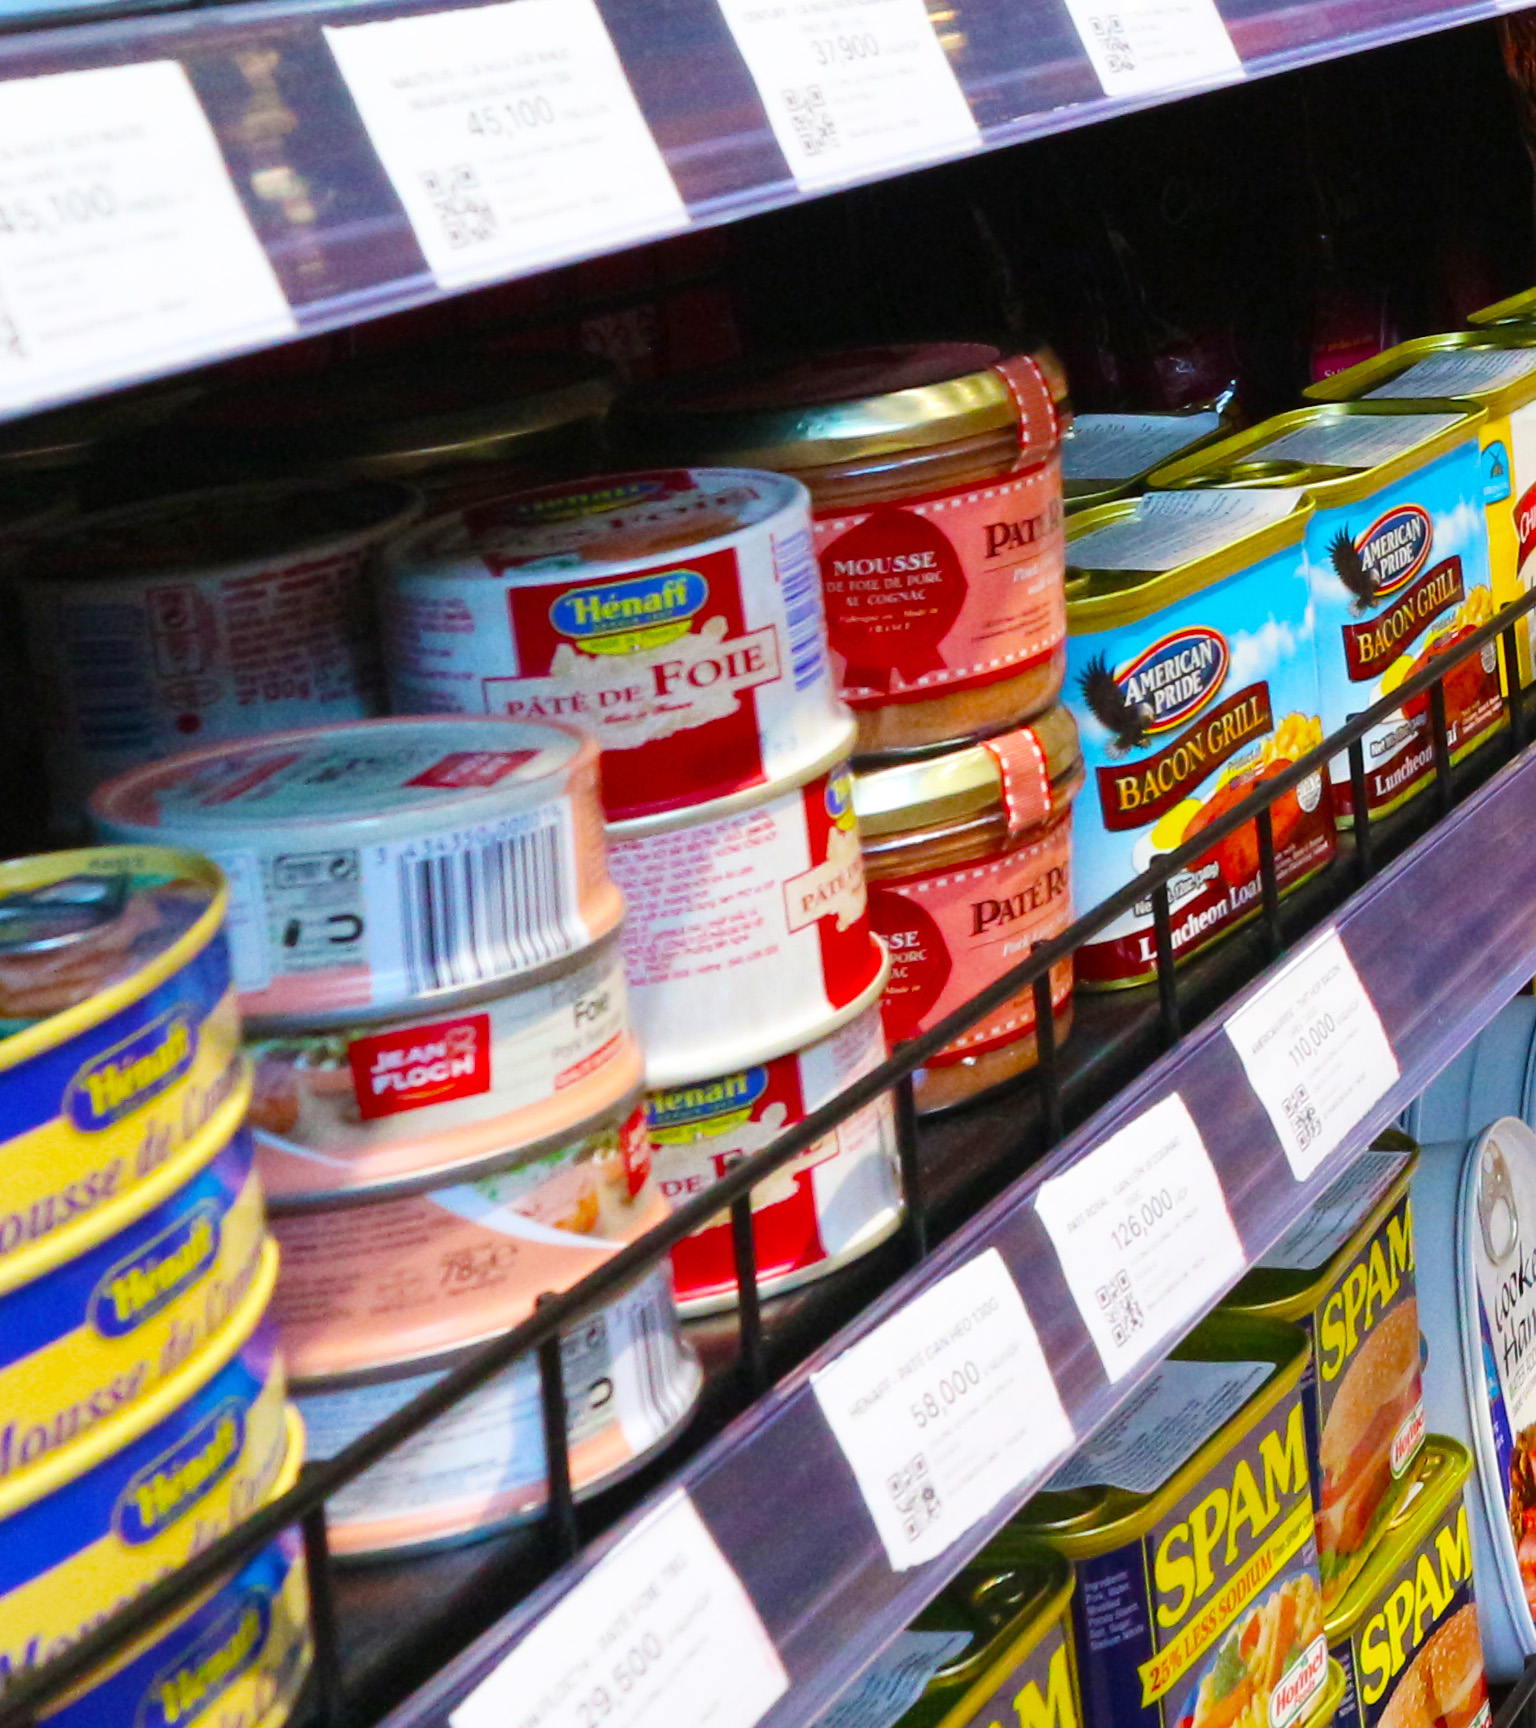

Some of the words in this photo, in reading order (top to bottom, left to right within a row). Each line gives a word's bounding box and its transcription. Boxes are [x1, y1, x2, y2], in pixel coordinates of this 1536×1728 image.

[812, 31, 881, 69] 37,900
[833, 550, 938, 577] MOUSSE
[1362, 514, 1421, 569] AMERICAN
[1380, 542, 1414, 577] PRIDE
[566, 573, 690, 627] Hénaff
[1357, 596, 1415, 663] BACON
[1416, 568, 1460, 617] GRILL
[506, 686, 590, 719] PÂTÉ
[599, 688, 644, 711] DE
[651, 641, 766, 698] FOIE
[1124, 638, 1213, 707] AMERICAN
[1154, 671, 1204, 716] PRIDE
[1114, 739, 1206, 812] BACON
[1208, 696, 1265, 760] GRILL
[1374, 744, 1433, 796] Luncheon
[370, 1040, 447, 1073] JEAN
[1110, 1187, 1173, 1252] 126,000
[1319, 1202, 1417, 1382] SPAM
[910, 1360, 980, 1430] 58,000
[1155, 1402, 1309, 1627] SPAM
[1149, 1646, 1184, 1692] 25%
[1184, 1610, 1218, 1660] LESS
[1218, 1550, 1274, 1622] SODIUM
[1361, 1504, 1472, 1704] SPAM
[1274, 1645, 1323, 1715] Hormel
